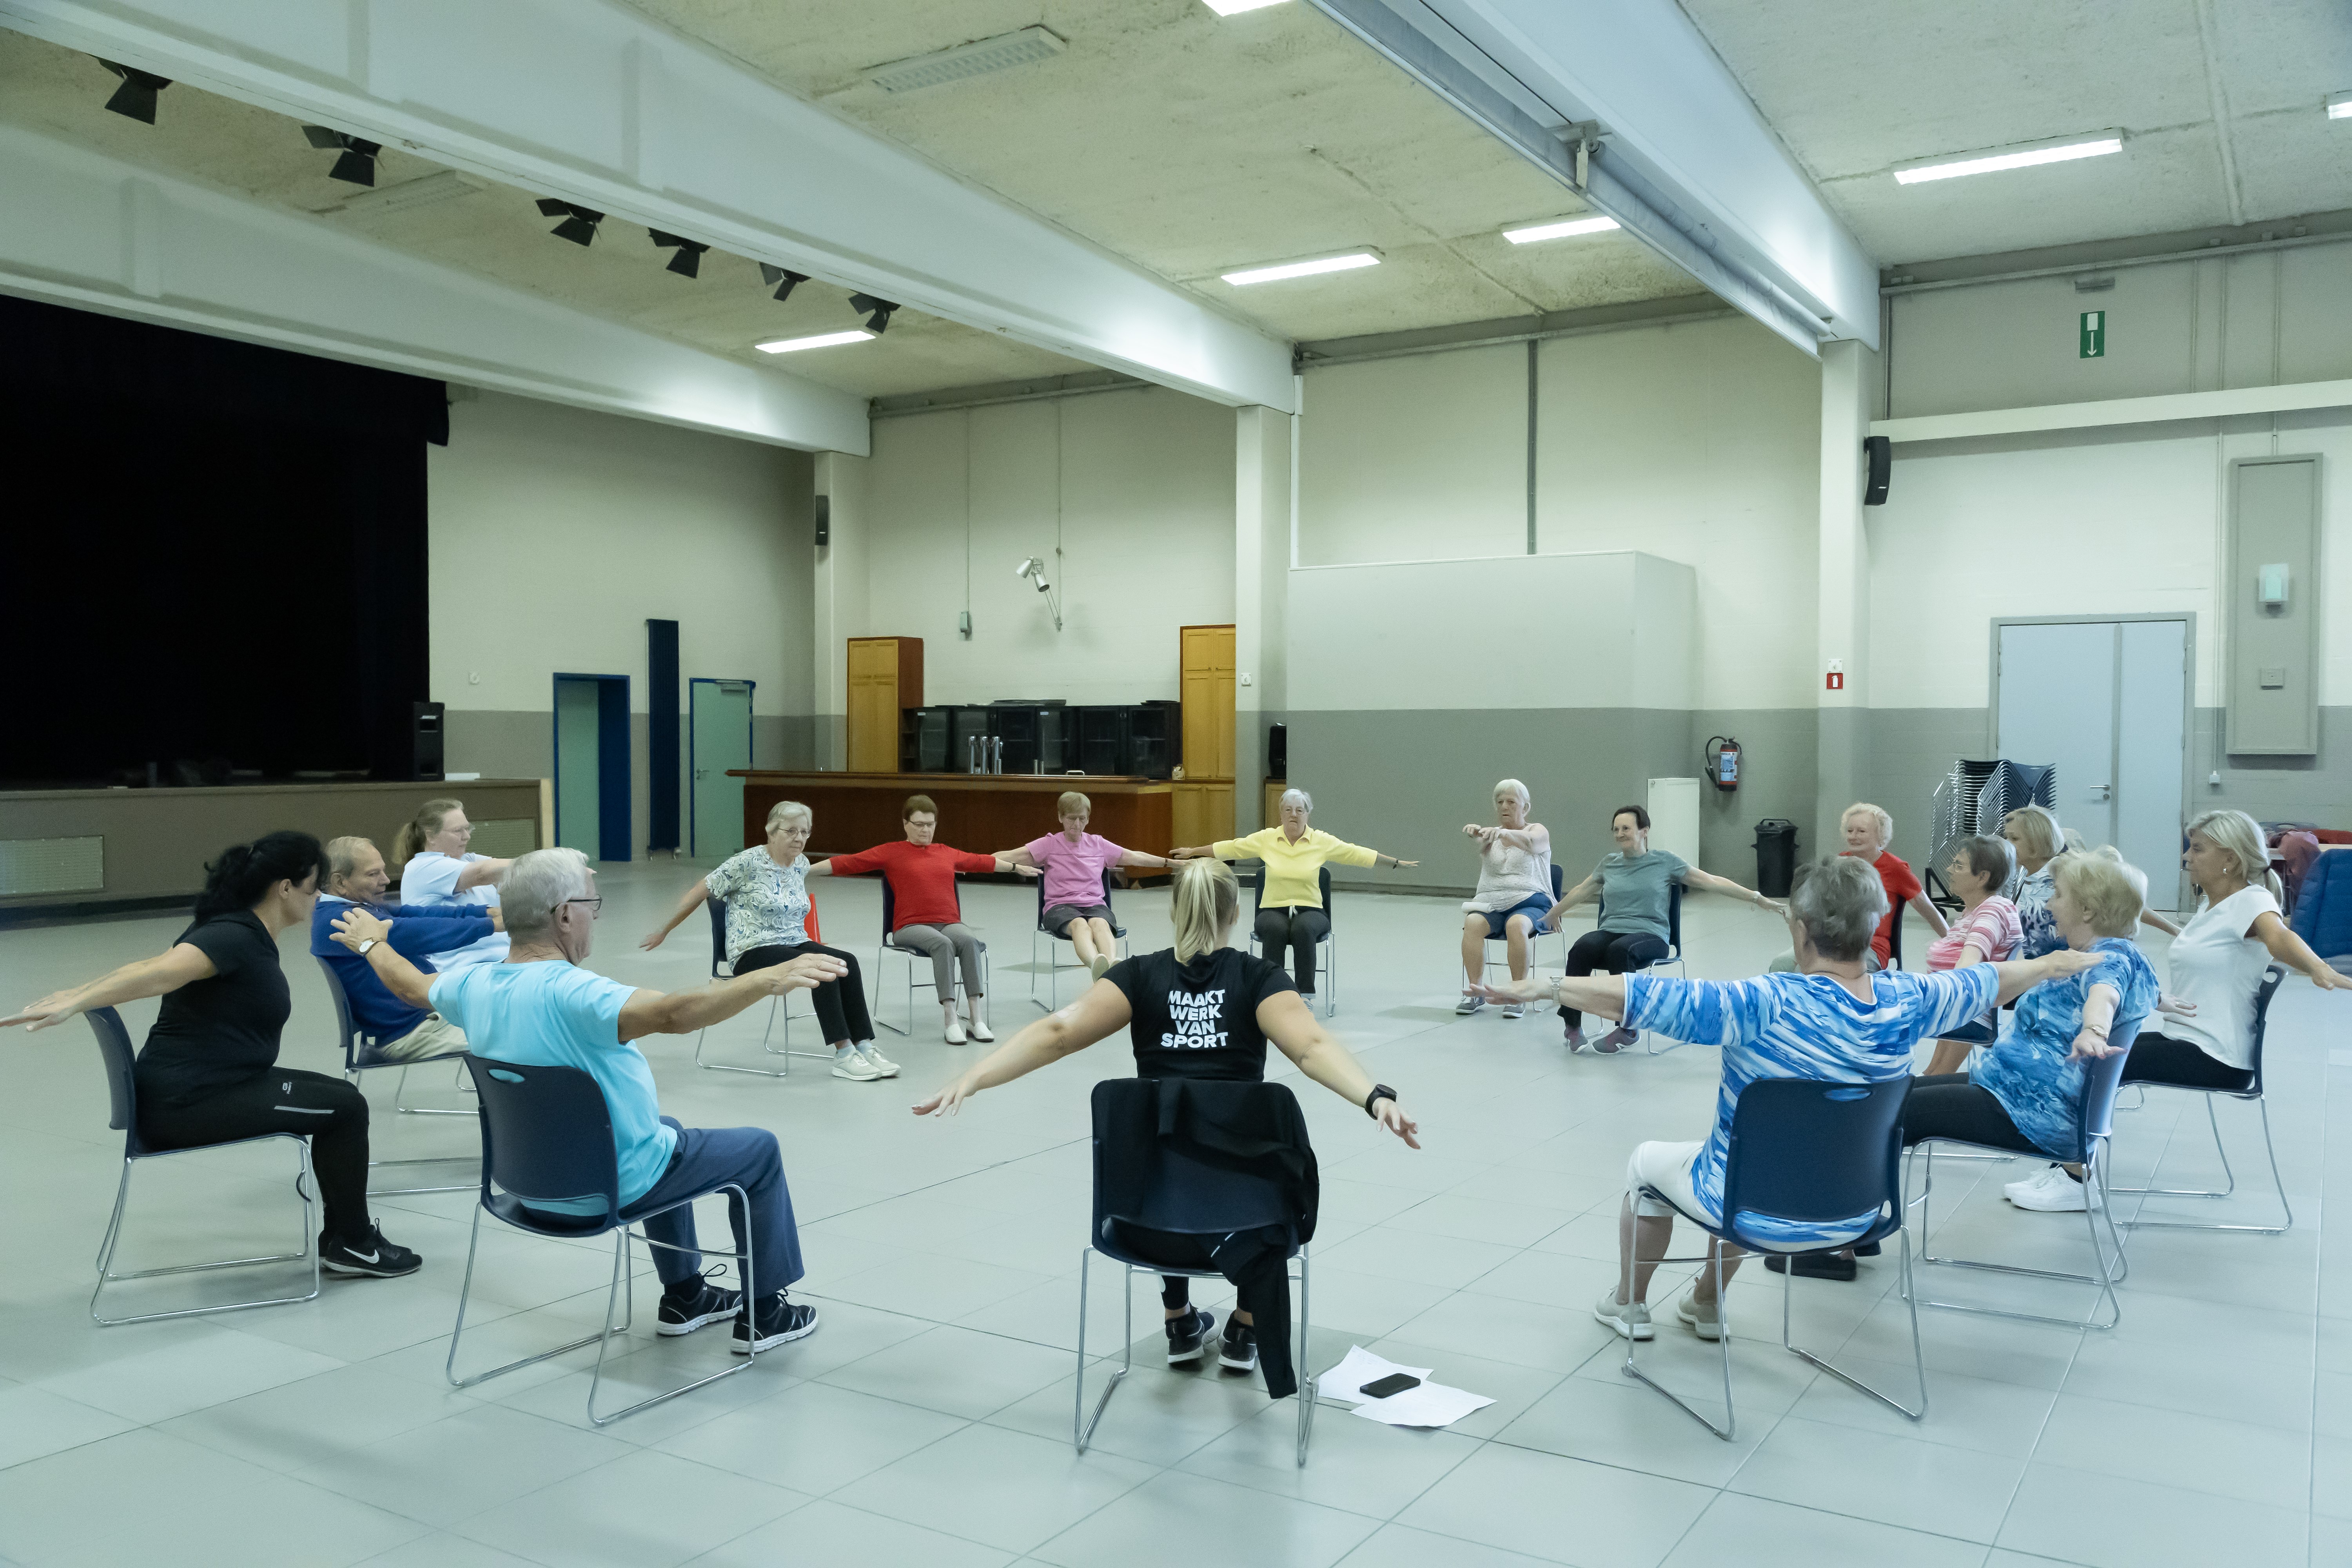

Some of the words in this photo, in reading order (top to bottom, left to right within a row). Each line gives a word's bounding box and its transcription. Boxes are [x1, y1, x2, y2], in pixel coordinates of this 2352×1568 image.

[1167, 989, 1225, 1007] MAAKT
[1170, 1005, 1222, 1021] WERK
[1176, 1020, 1215, 1035] VAN
[1161, 1032, 1228, 1048] SPORT
